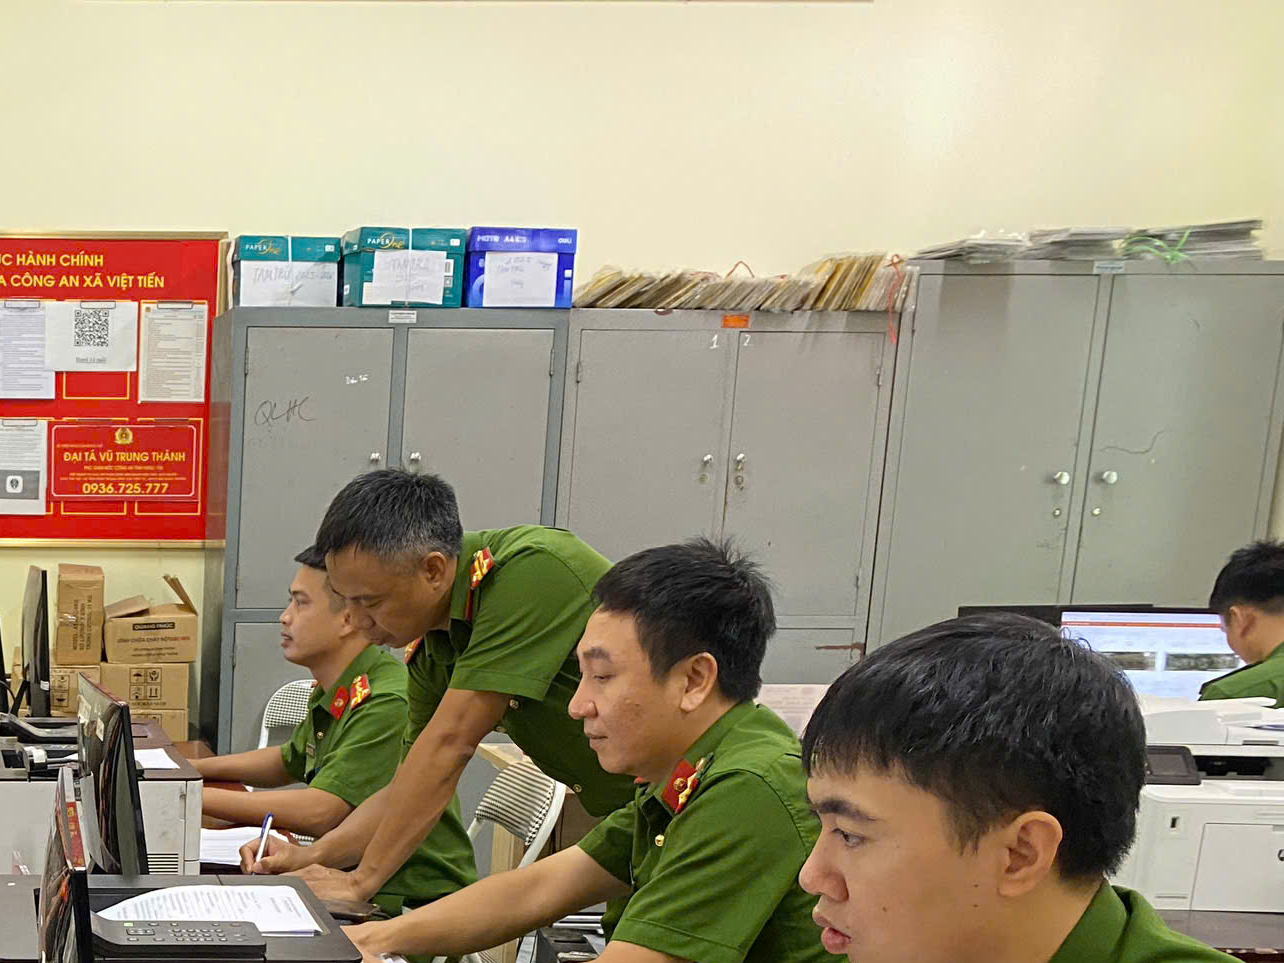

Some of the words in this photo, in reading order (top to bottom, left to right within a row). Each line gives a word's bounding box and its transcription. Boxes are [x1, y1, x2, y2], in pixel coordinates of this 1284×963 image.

[245, 243, 267, 251] PAPER
[16, 250, 56, 266] HÀNH
[59, 251, 104, 267] CHÍNH
[10, 271, 56, 287] CÔNG
[59, 275, 79, 287] AN
[83, 273, 103, 287] XÃ
[107, 273, 134, 290] VIỆT
[137, 272, 165, 288] TIẾN
[709, 334, 720, 350] 1
[63, 452, 82, 464] ĐẠI
[84, 449, 97, 462] TÁ
[99, 449, 113, 462] VŨ
[115, 452, 149, 462] TRUNG
[82, 483, 169, 494] 0936.725.777
